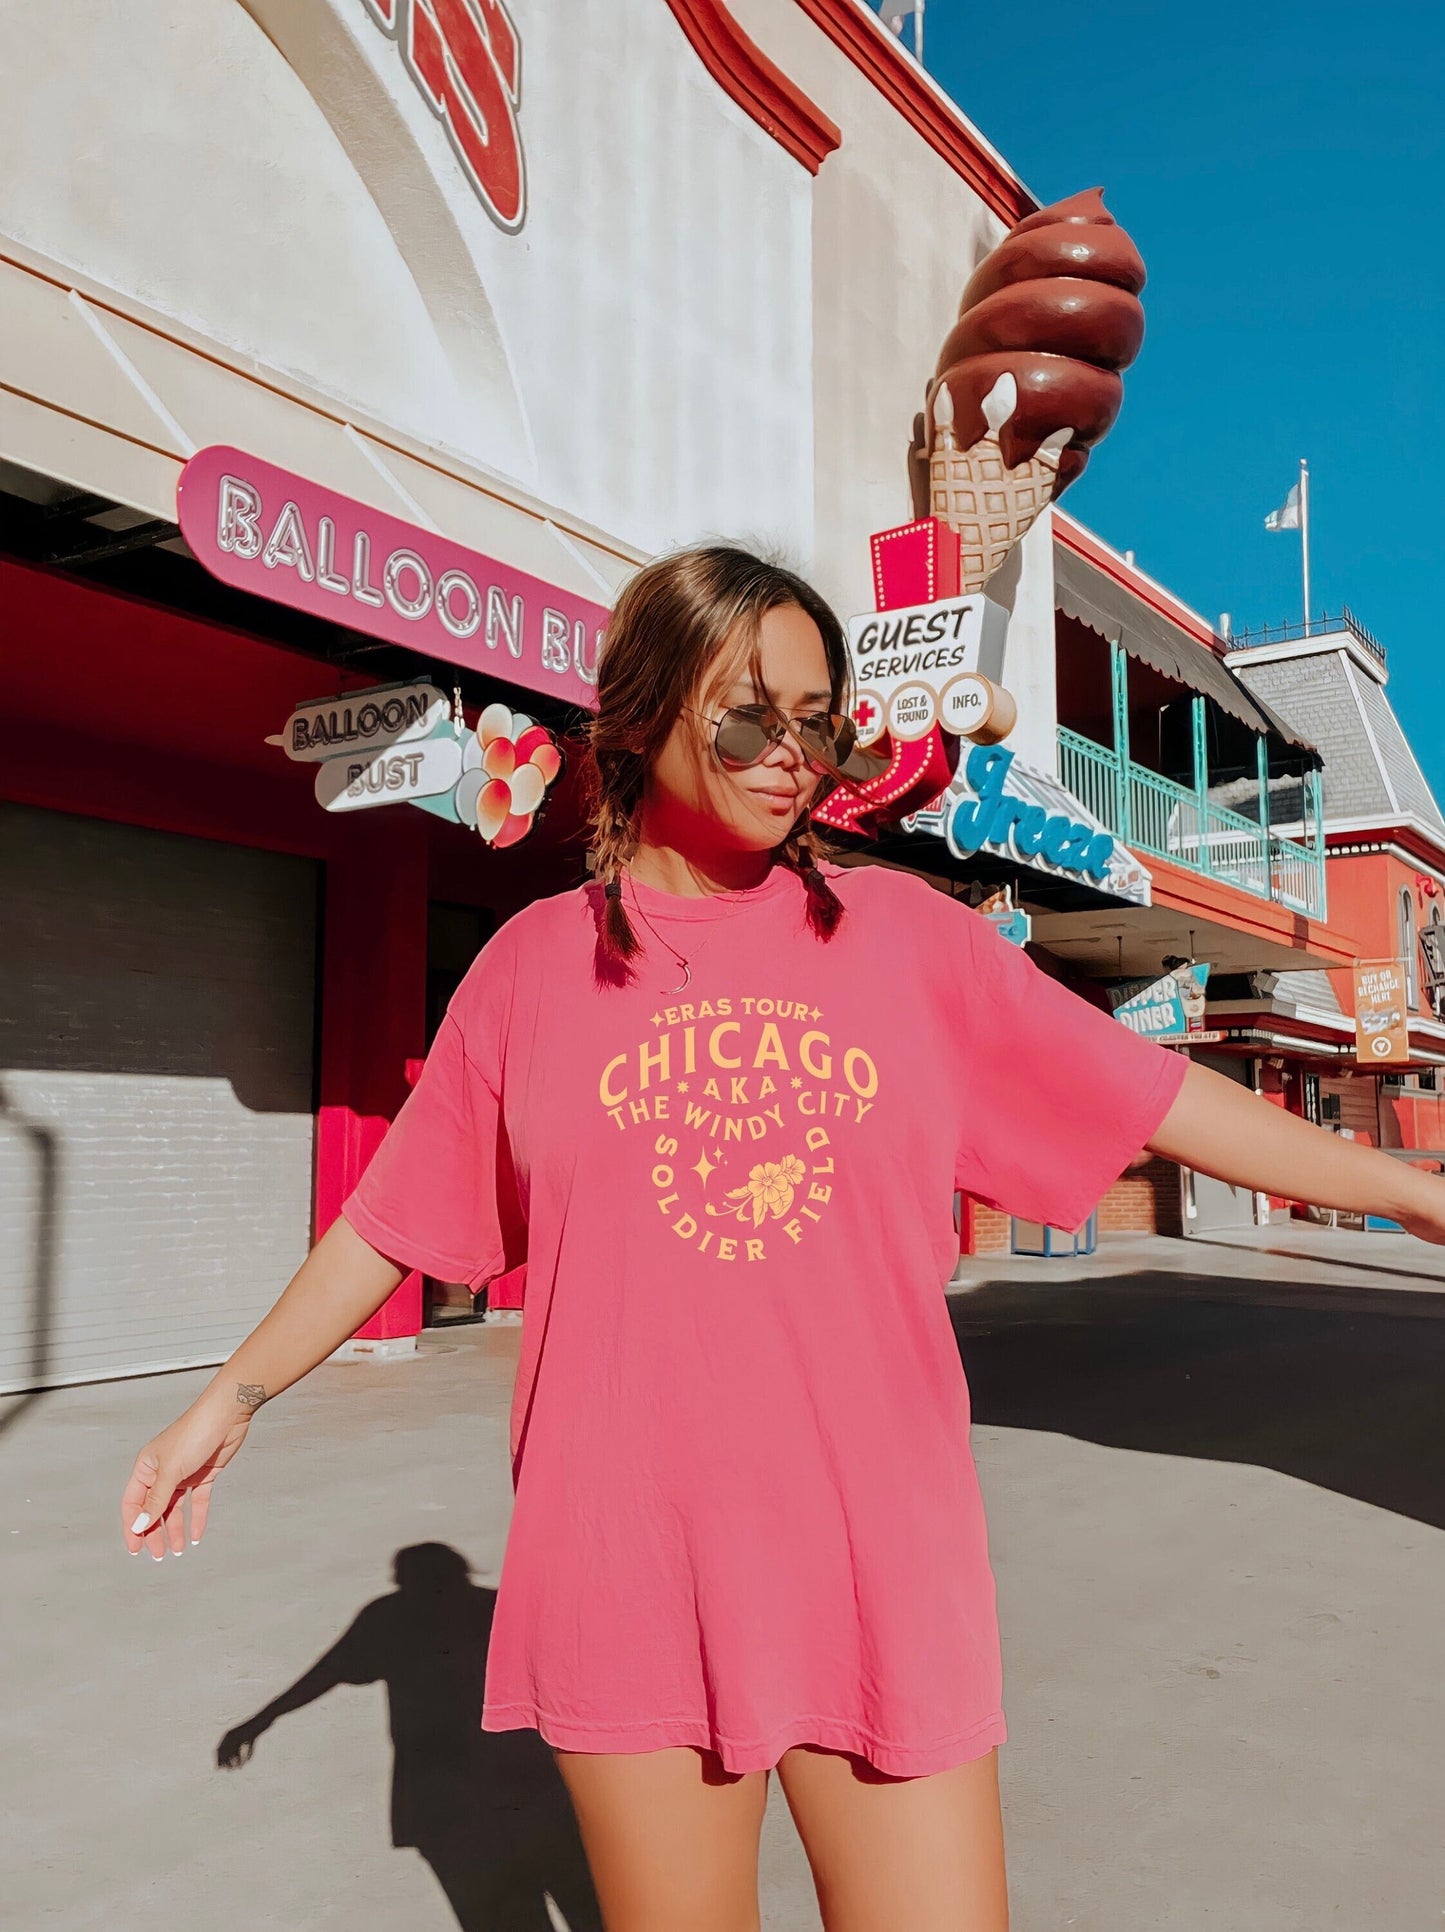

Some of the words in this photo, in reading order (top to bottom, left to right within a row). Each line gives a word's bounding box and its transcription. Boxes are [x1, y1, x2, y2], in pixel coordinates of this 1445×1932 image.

[216, 473, 525, 659] BALLOON
[541, 606, 606, 685] BU
[856, 605, 973, 655] GUEST
[858, 645, 966, 682] SERVICES
[292, 692, 429, 751] BALLOON
[897, 696, 919, 710] LOST
[920, 694, 928, 707] &
[897, 709, 929, 724] FOUND
[347, 752, 425, 798] BUST
[663, 998, 733, 1026] ERAS
[740, 997, 809, 1022] TOUR
[1119, 1002, 1177, 1034] DINER
[599, 1021, 879, 1107] CHICAGO
[702, 1076, 778, 1105] AKA
[606, 1095, 670, 1131] THE
[683, 1101, 785, 1142] WINDY
[797, 1091, 874, 1124] CITY
[651, 1133, 767, 1262] SOLDIER
[782, 1126, 835, 1245] FIELD
